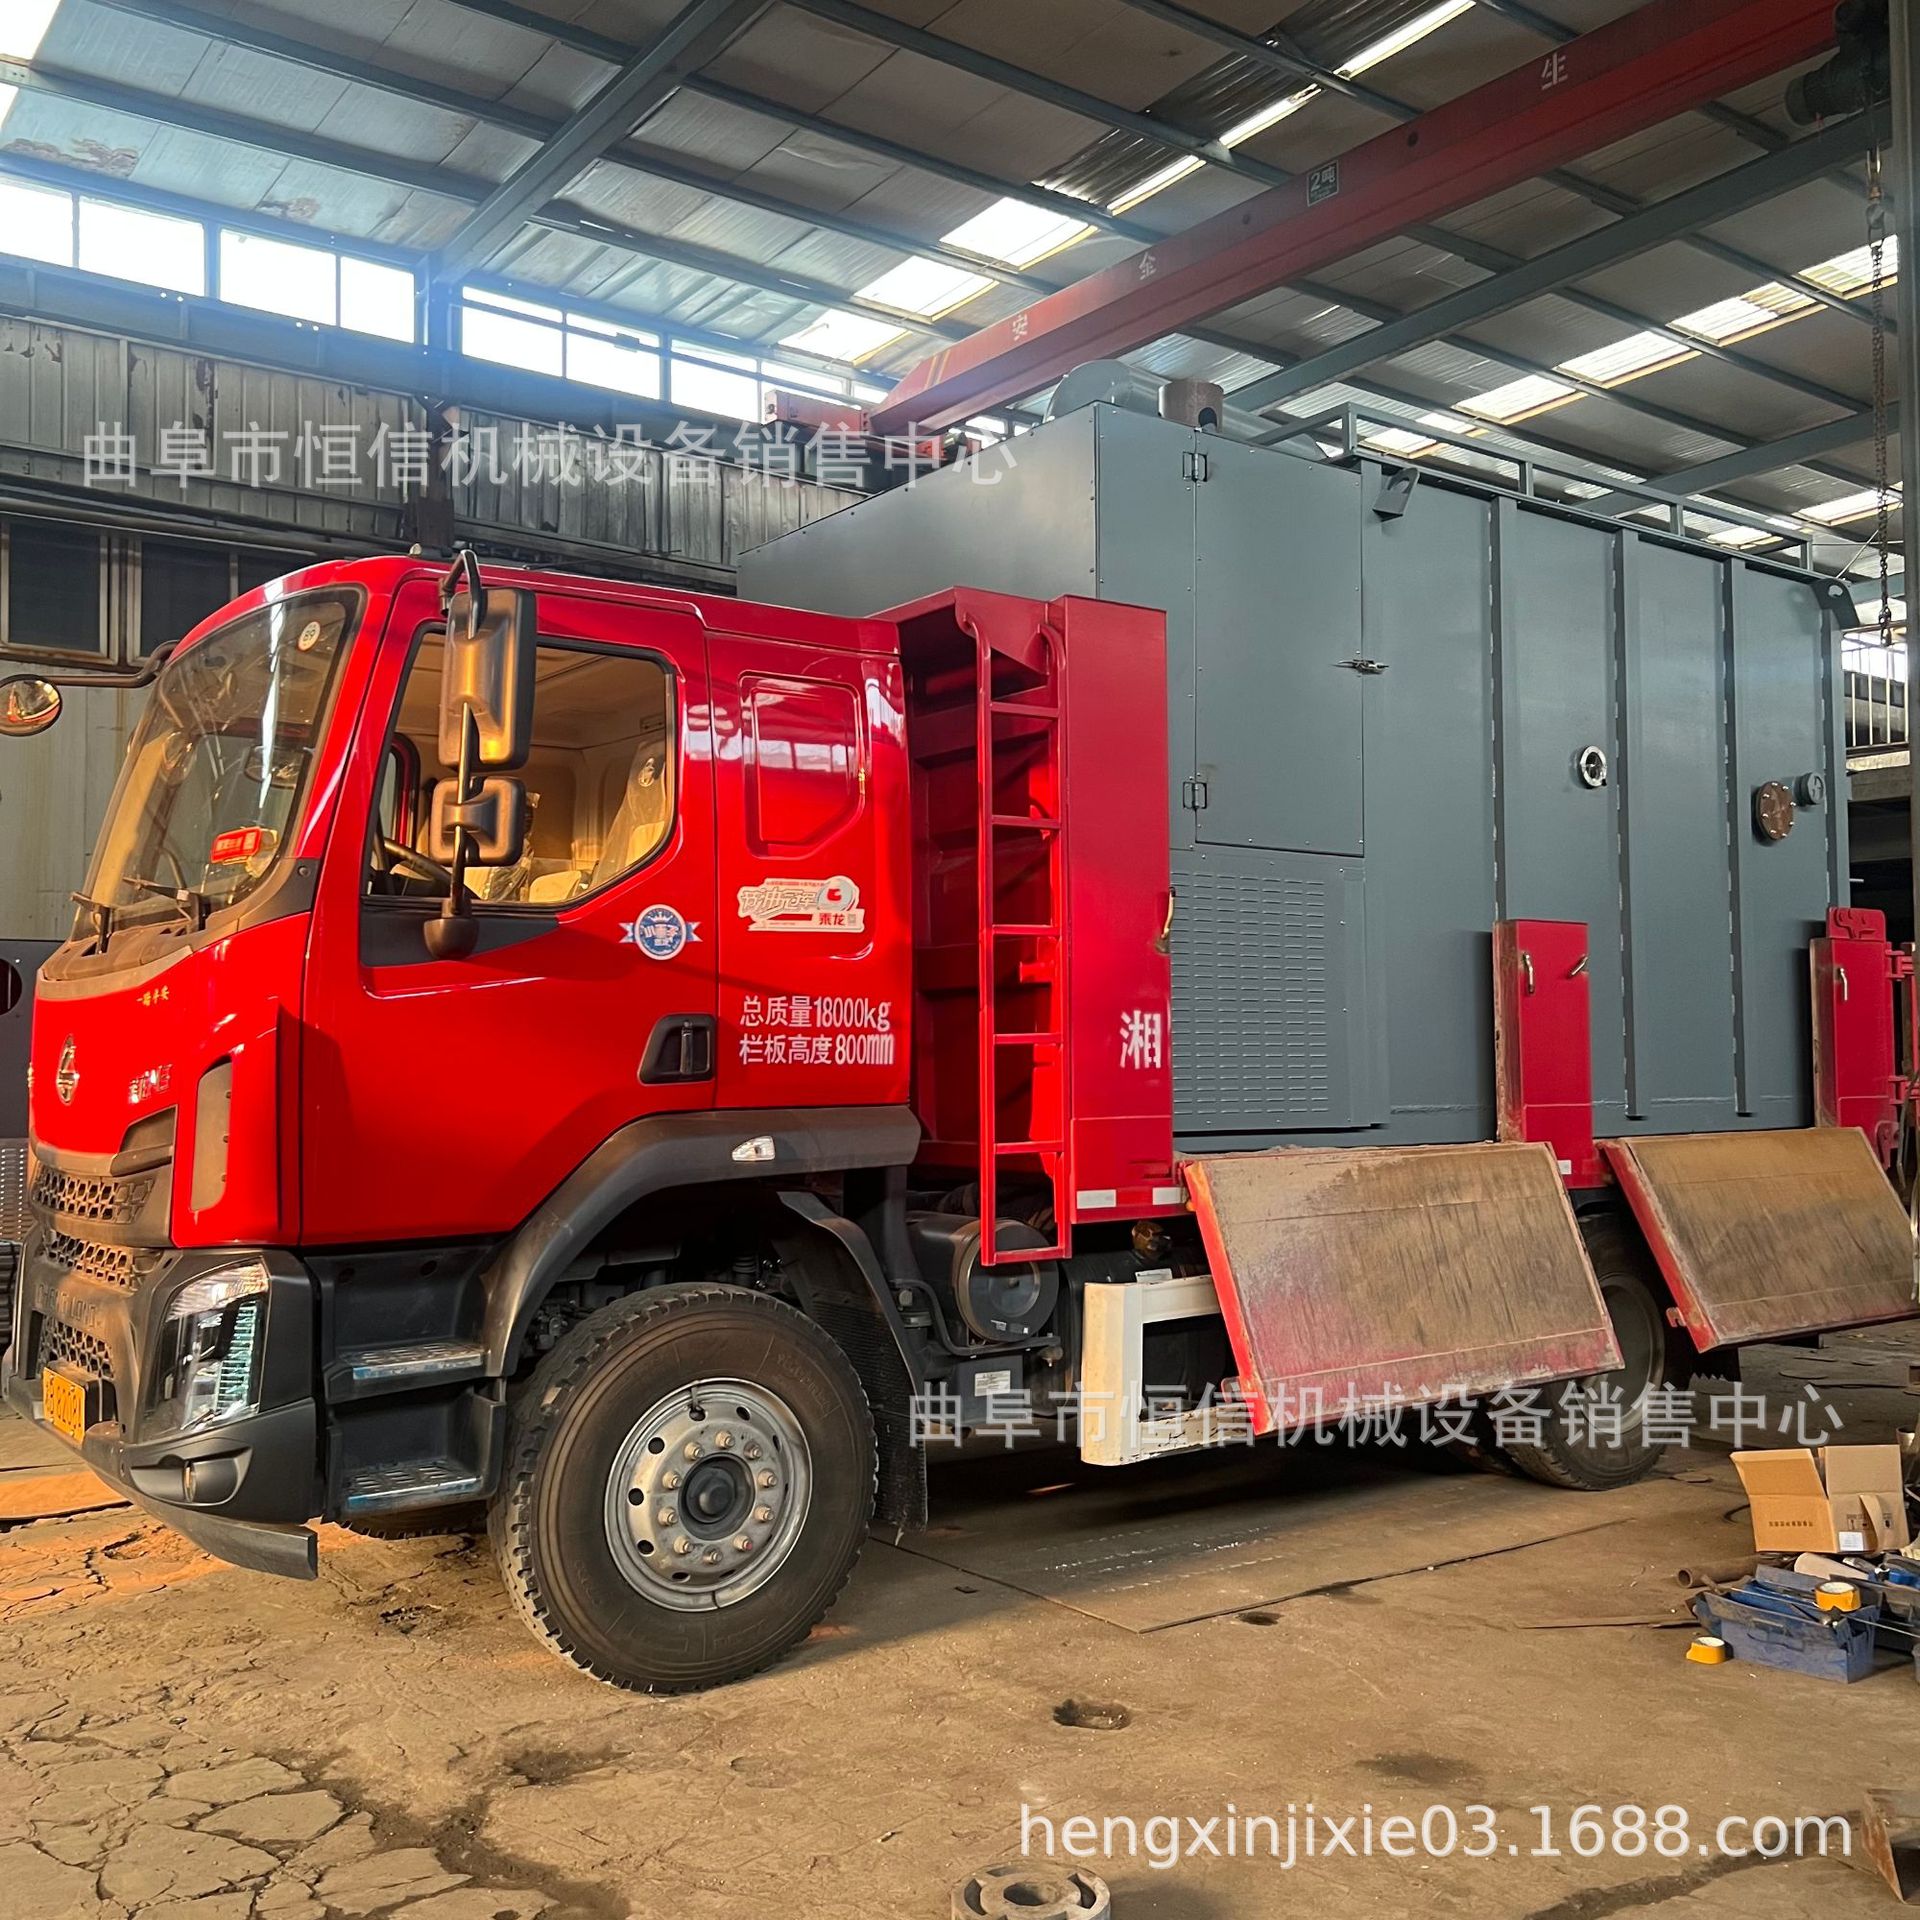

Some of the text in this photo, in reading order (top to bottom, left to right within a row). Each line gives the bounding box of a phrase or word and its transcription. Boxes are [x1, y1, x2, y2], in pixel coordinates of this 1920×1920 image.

[1541, 52, 1568, 90] 生
[739, 995, 891, 1032] 总质量18000kg
[739, 1033, 895, 1065] 栏板高度800mm
[1119, 1009, 1161, 1070] 湘
